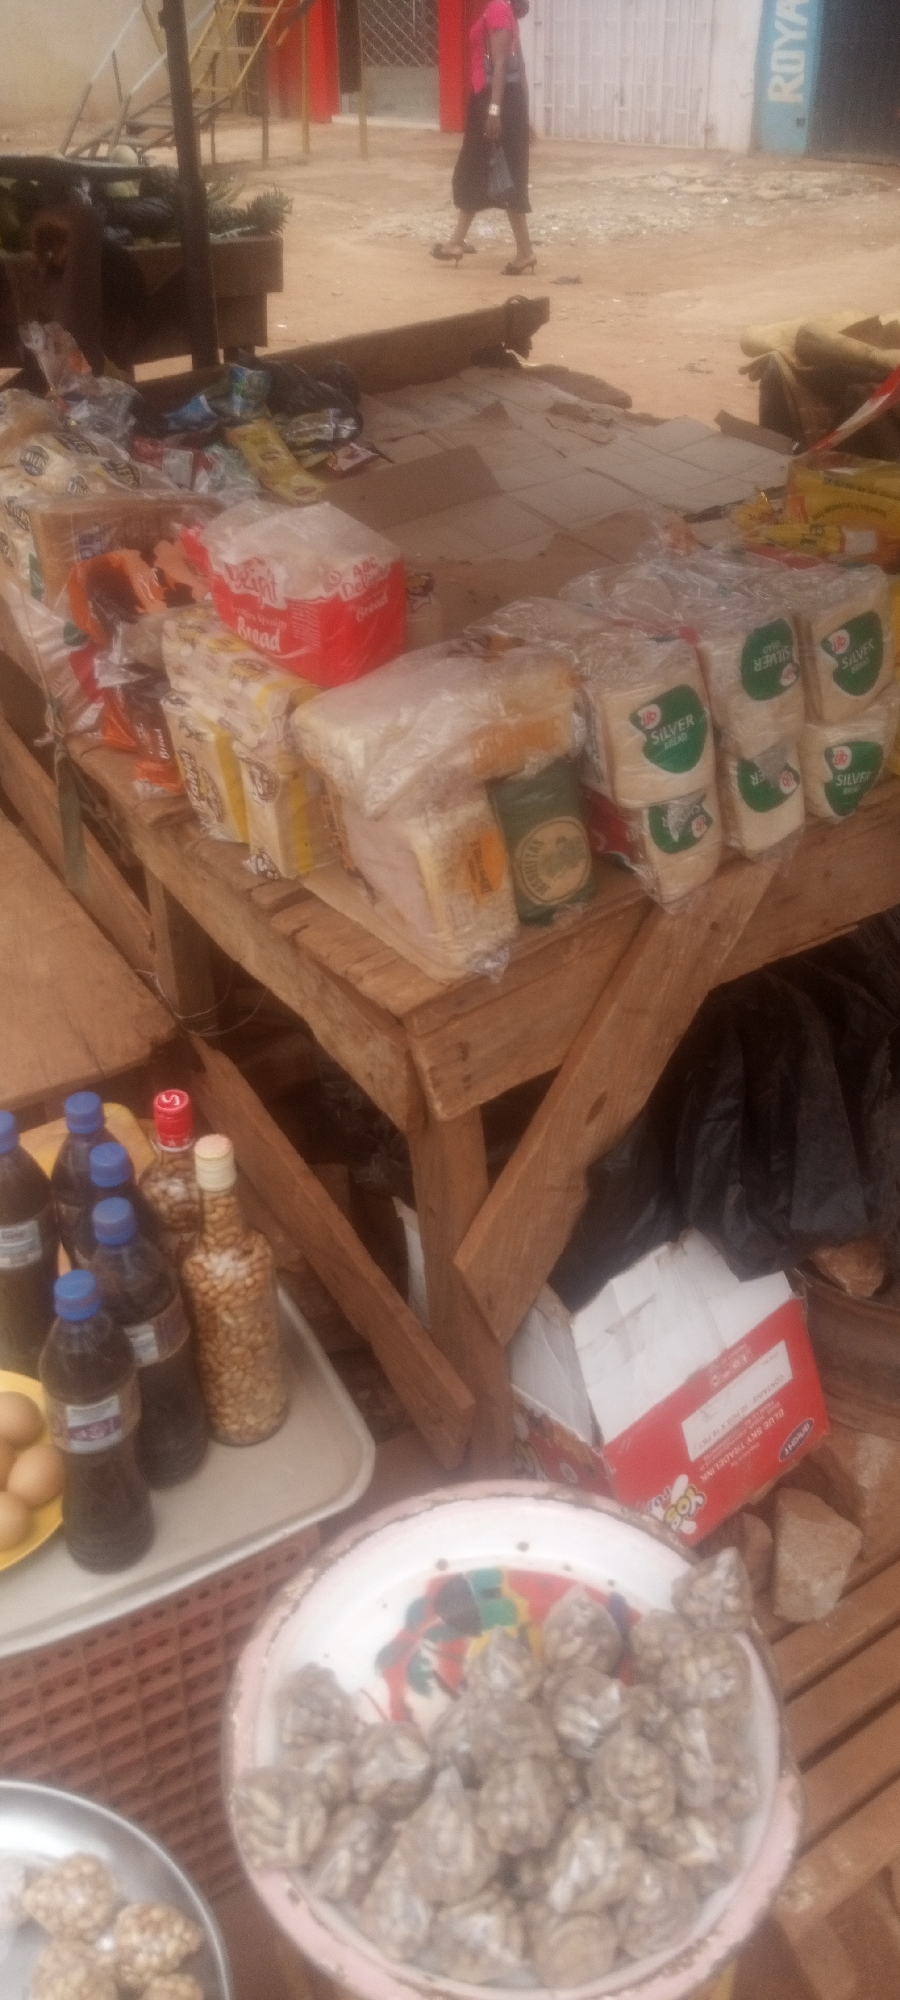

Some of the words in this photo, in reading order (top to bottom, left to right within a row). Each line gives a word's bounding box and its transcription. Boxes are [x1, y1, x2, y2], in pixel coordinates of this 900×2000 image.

[237, 615, 282, 653] Bread
[753, 645, 792, 672] SILVER
[841, 638, 876, 670] SILVER
[651, 714, 695, 745] SILVER
[663, 732, 689, 750] BREAD
[762, 1407, 785, 1430] BLUE
[746, 1424, 764, 1444] SKY
[700, 1440, 747, 1482] TRADELINK
